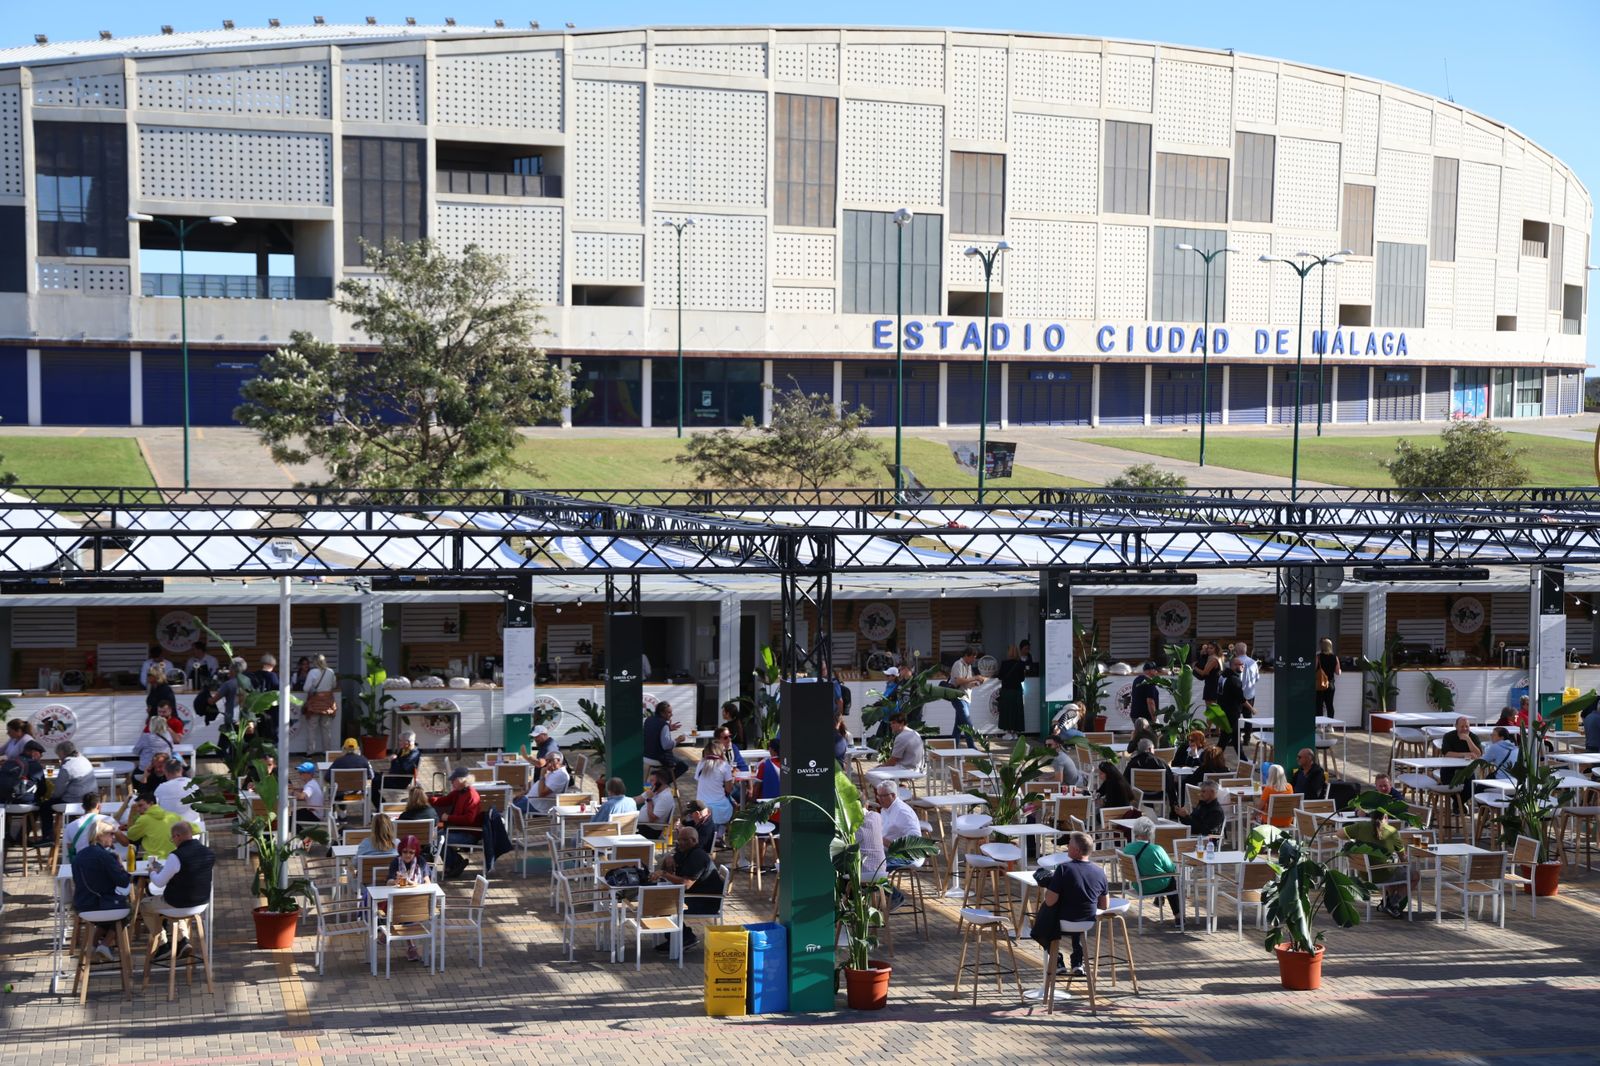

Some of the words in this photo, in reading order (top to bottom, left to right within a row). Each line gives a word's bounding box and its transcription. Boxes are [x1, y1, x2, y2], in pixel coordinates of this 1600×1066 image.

[873, 320, 1065, 351] ESTADIO
[1097, 325, 1229, 354] CIUDAD
[1256, 328, 1290, 354] DE
[1313, 325, 1409, 356] MÁLAGA
